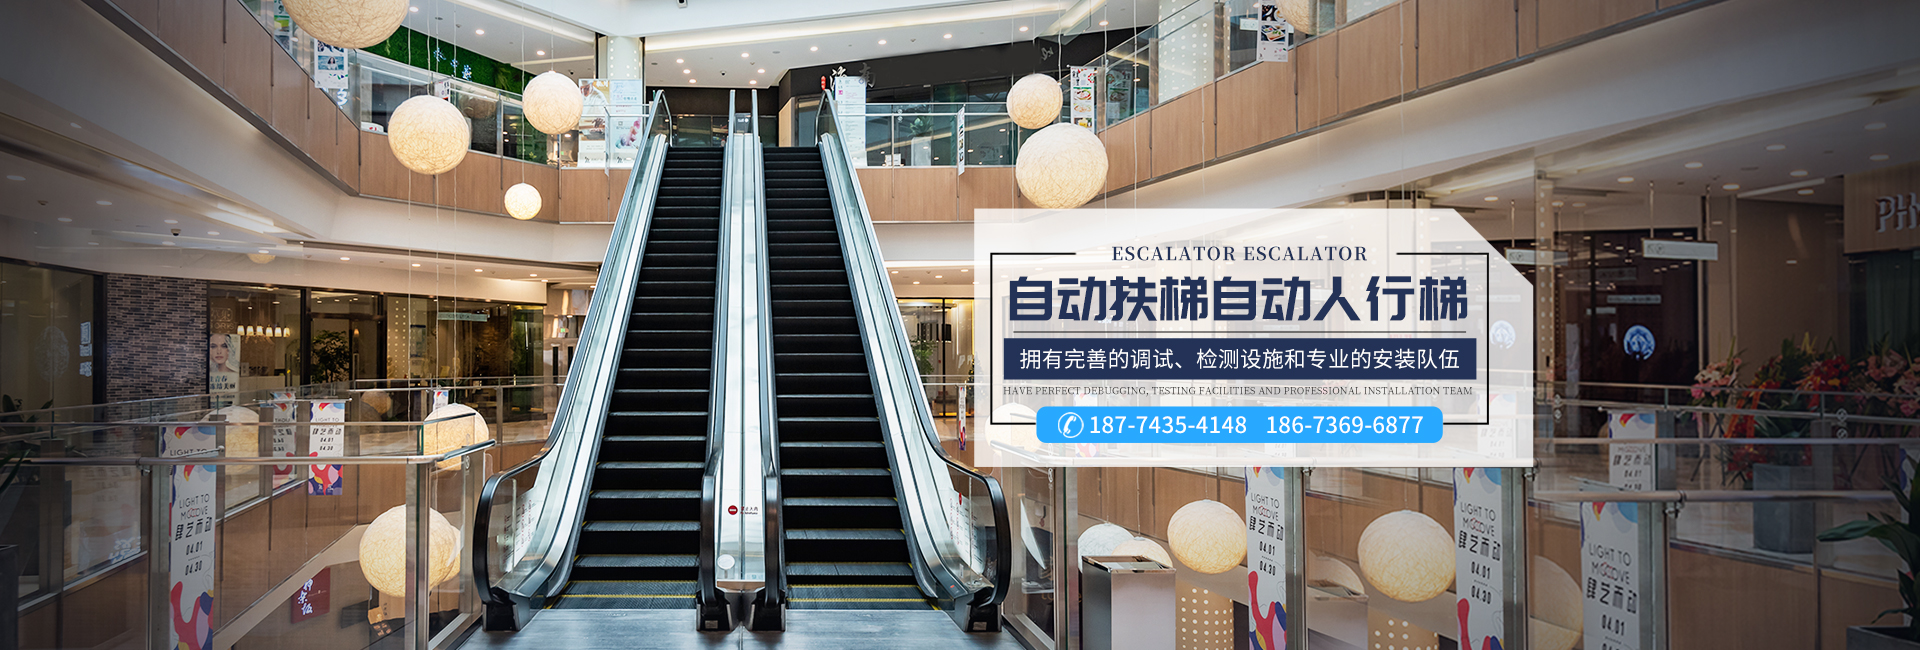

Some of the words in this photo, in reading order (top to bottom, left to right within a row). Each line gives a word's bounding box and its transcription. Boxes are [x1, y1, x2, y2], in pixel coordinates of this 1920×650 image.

[179, 495, 199, 509] LIGHT
[200, 493, 210, 504] TO
[1250, 492, 1269, 505] LIGHT
[1270, 498, 1280, 509] TO
[1460, 502, 1482, 517] LIGHT
[1484, 507, 1496, 521] TO
[185, 540, 203, 556] 04.01
[1259, 540, 1275, 556] 04.01
[1588, 543, 1615, 562] LIGHT
[1617, 550, 1632, 567] TO
[185, 560, 203, 576] 04.30
[1259, 560, 1276, 576] 04.30
[1471, 561, 1491, 580] 04.01
[1471, 585, 1492, 605] 04.30
